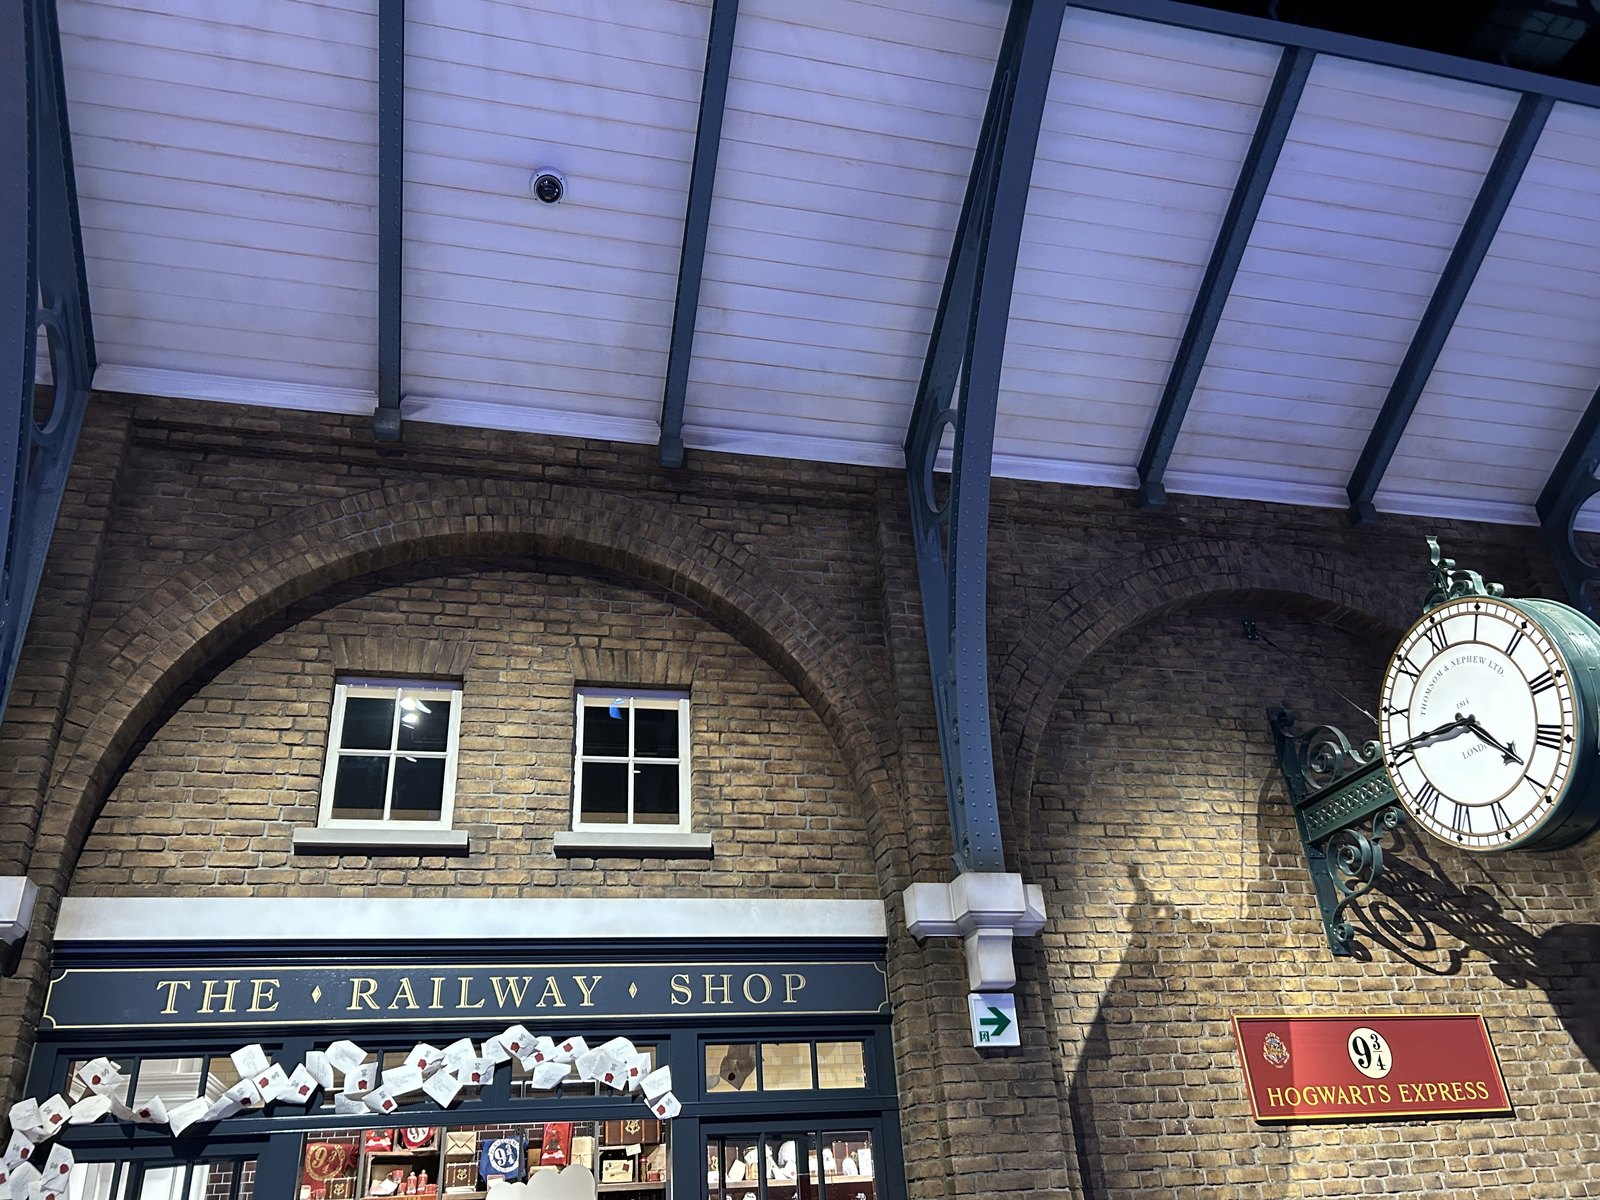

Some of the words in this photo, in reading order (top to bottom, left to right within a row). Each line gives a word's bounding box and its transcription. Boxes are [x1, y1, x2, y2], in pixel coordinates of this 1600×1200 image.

[1450, 655, 1487, 668] NEPHEW
[156, 978, 281, 1014] THE
[346, 974, 603, 1011] RAILWAY
[670, 973, 808, 1006] SHOP
[1266, 1083, 1392, 1107] HOGWARTS
[1397, 1080, 1490, 1104] EXPRESS
